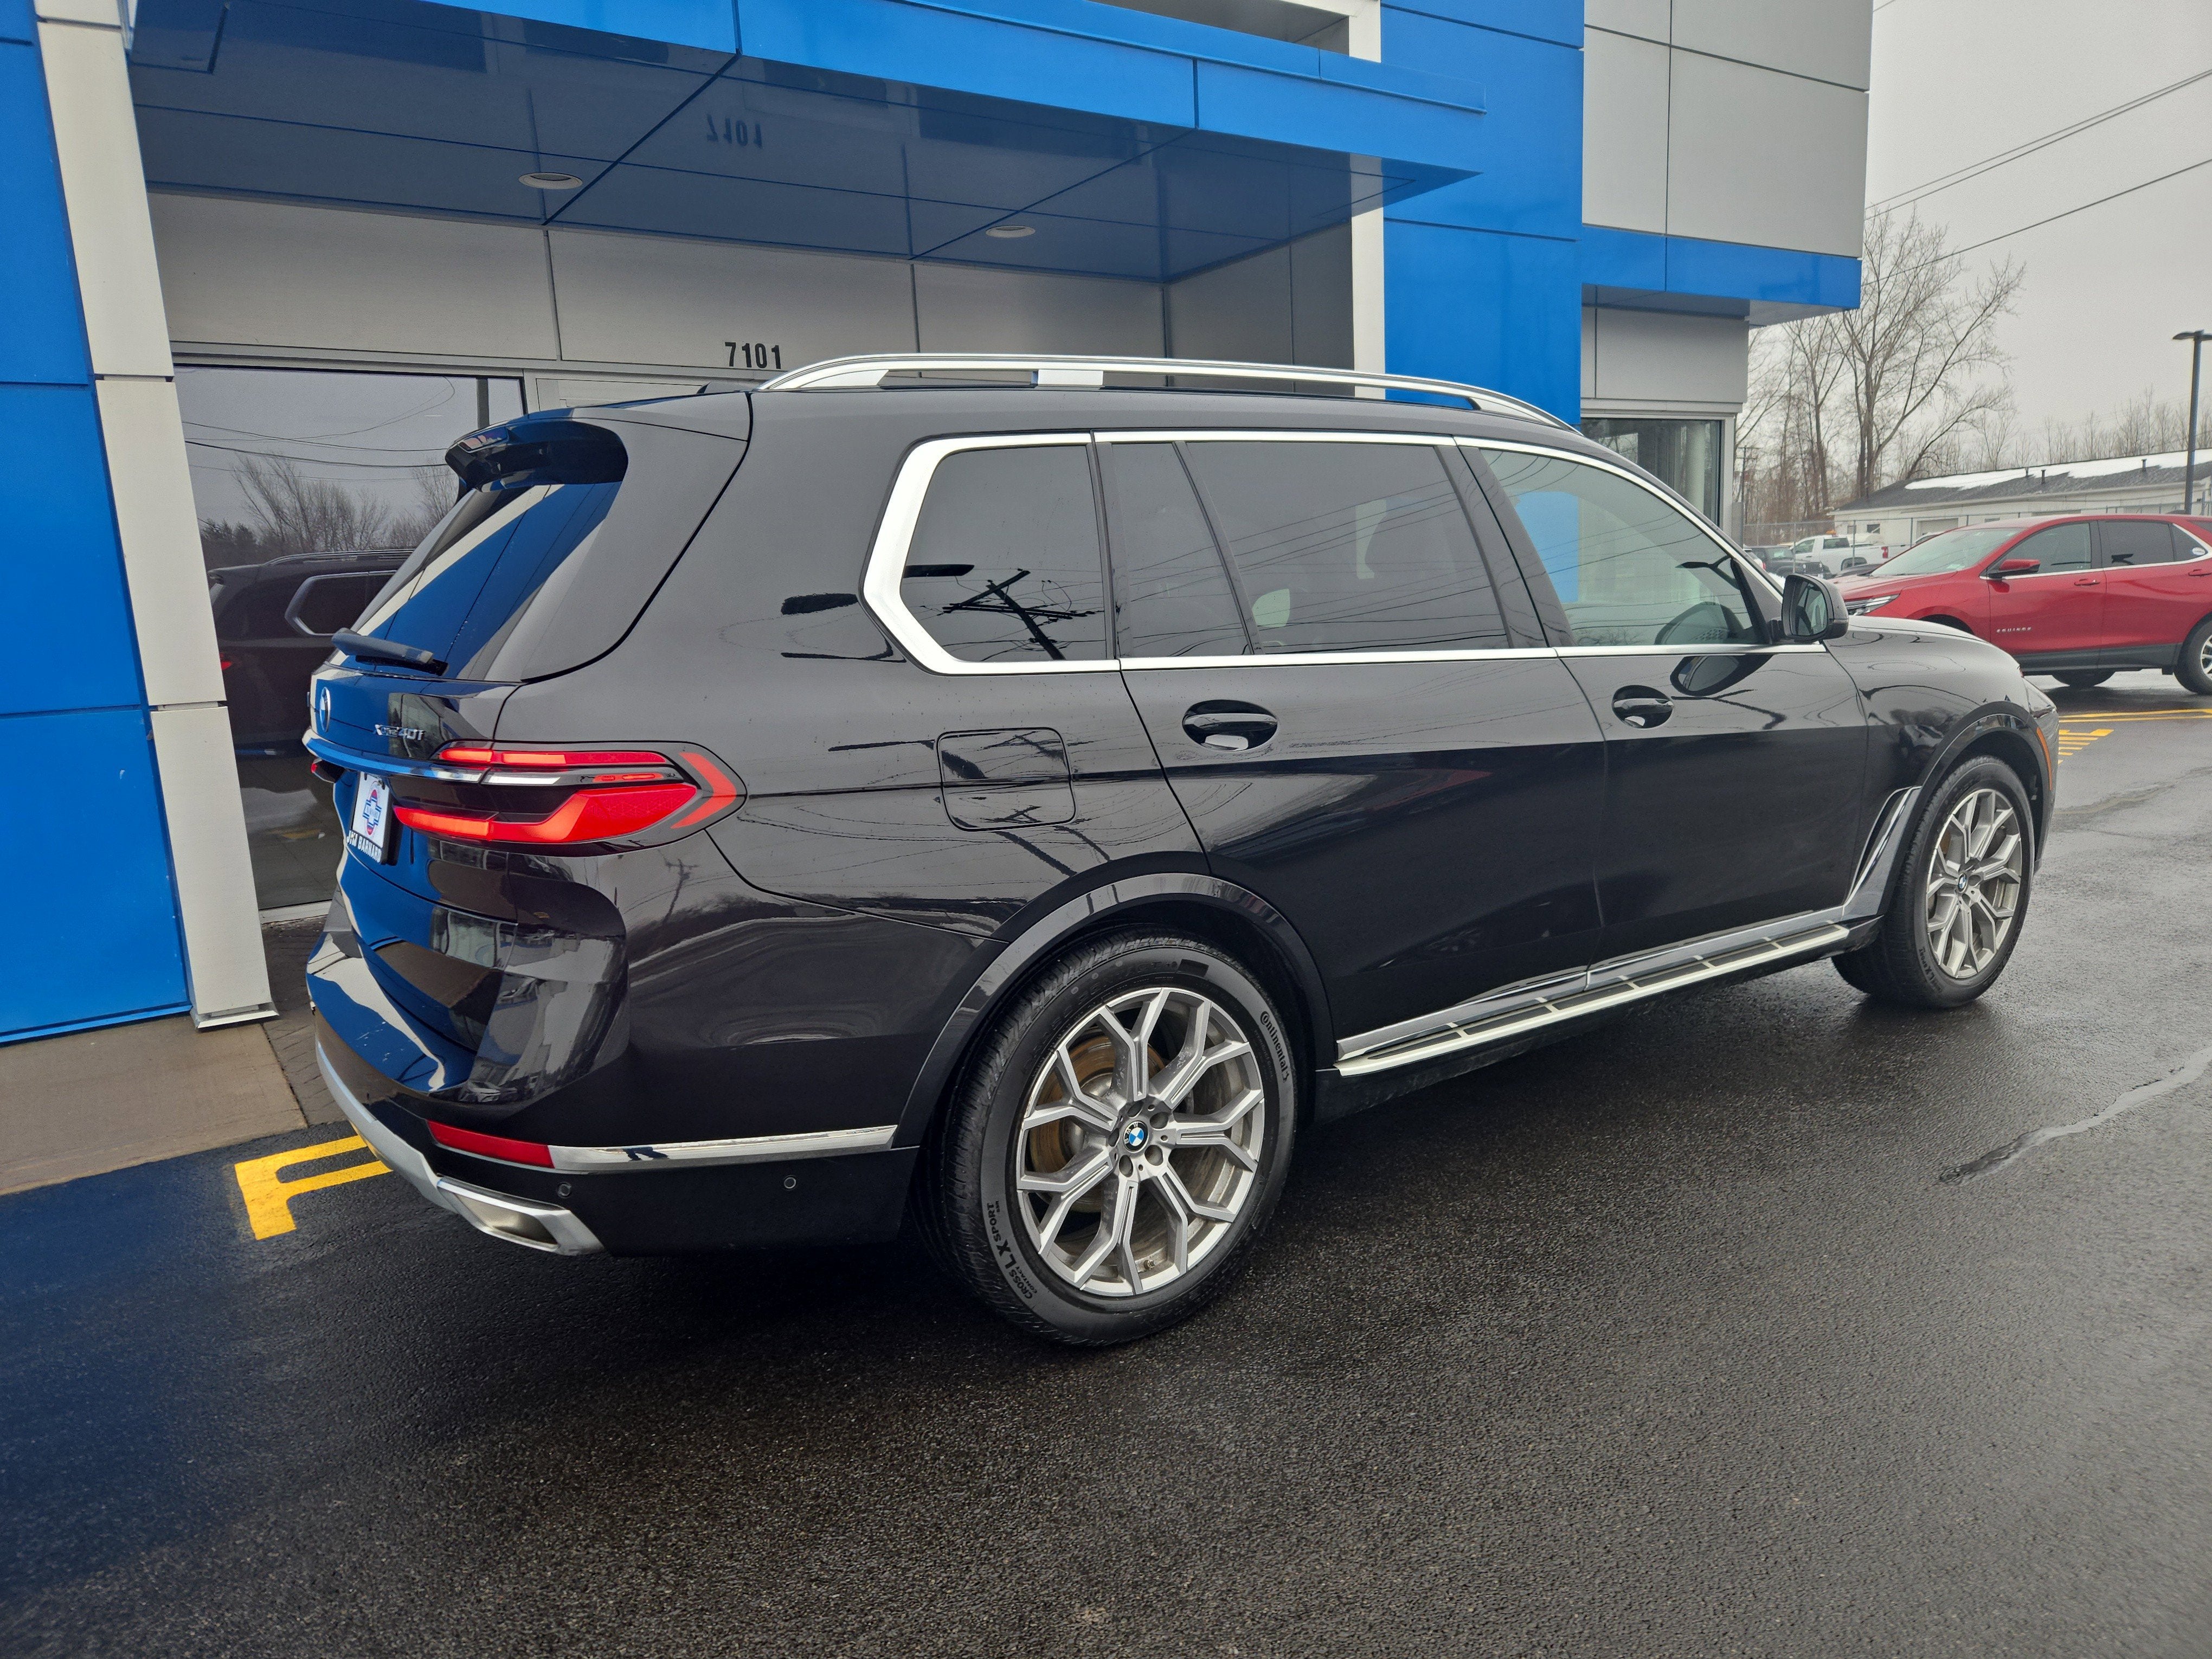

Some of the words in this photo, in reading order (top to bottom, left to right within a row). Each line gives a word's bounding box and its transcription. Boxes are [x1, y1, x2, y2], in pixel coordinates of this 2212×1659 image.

[724, 342, 782, 369] 7101
[357, 835, 382, 863] BARNARD
[1260, 1011, 1288, 1073] Continental
[987, 1202, 1001, 1242] SPORT
[1008, 1269, 1033, 1299] CROSS
